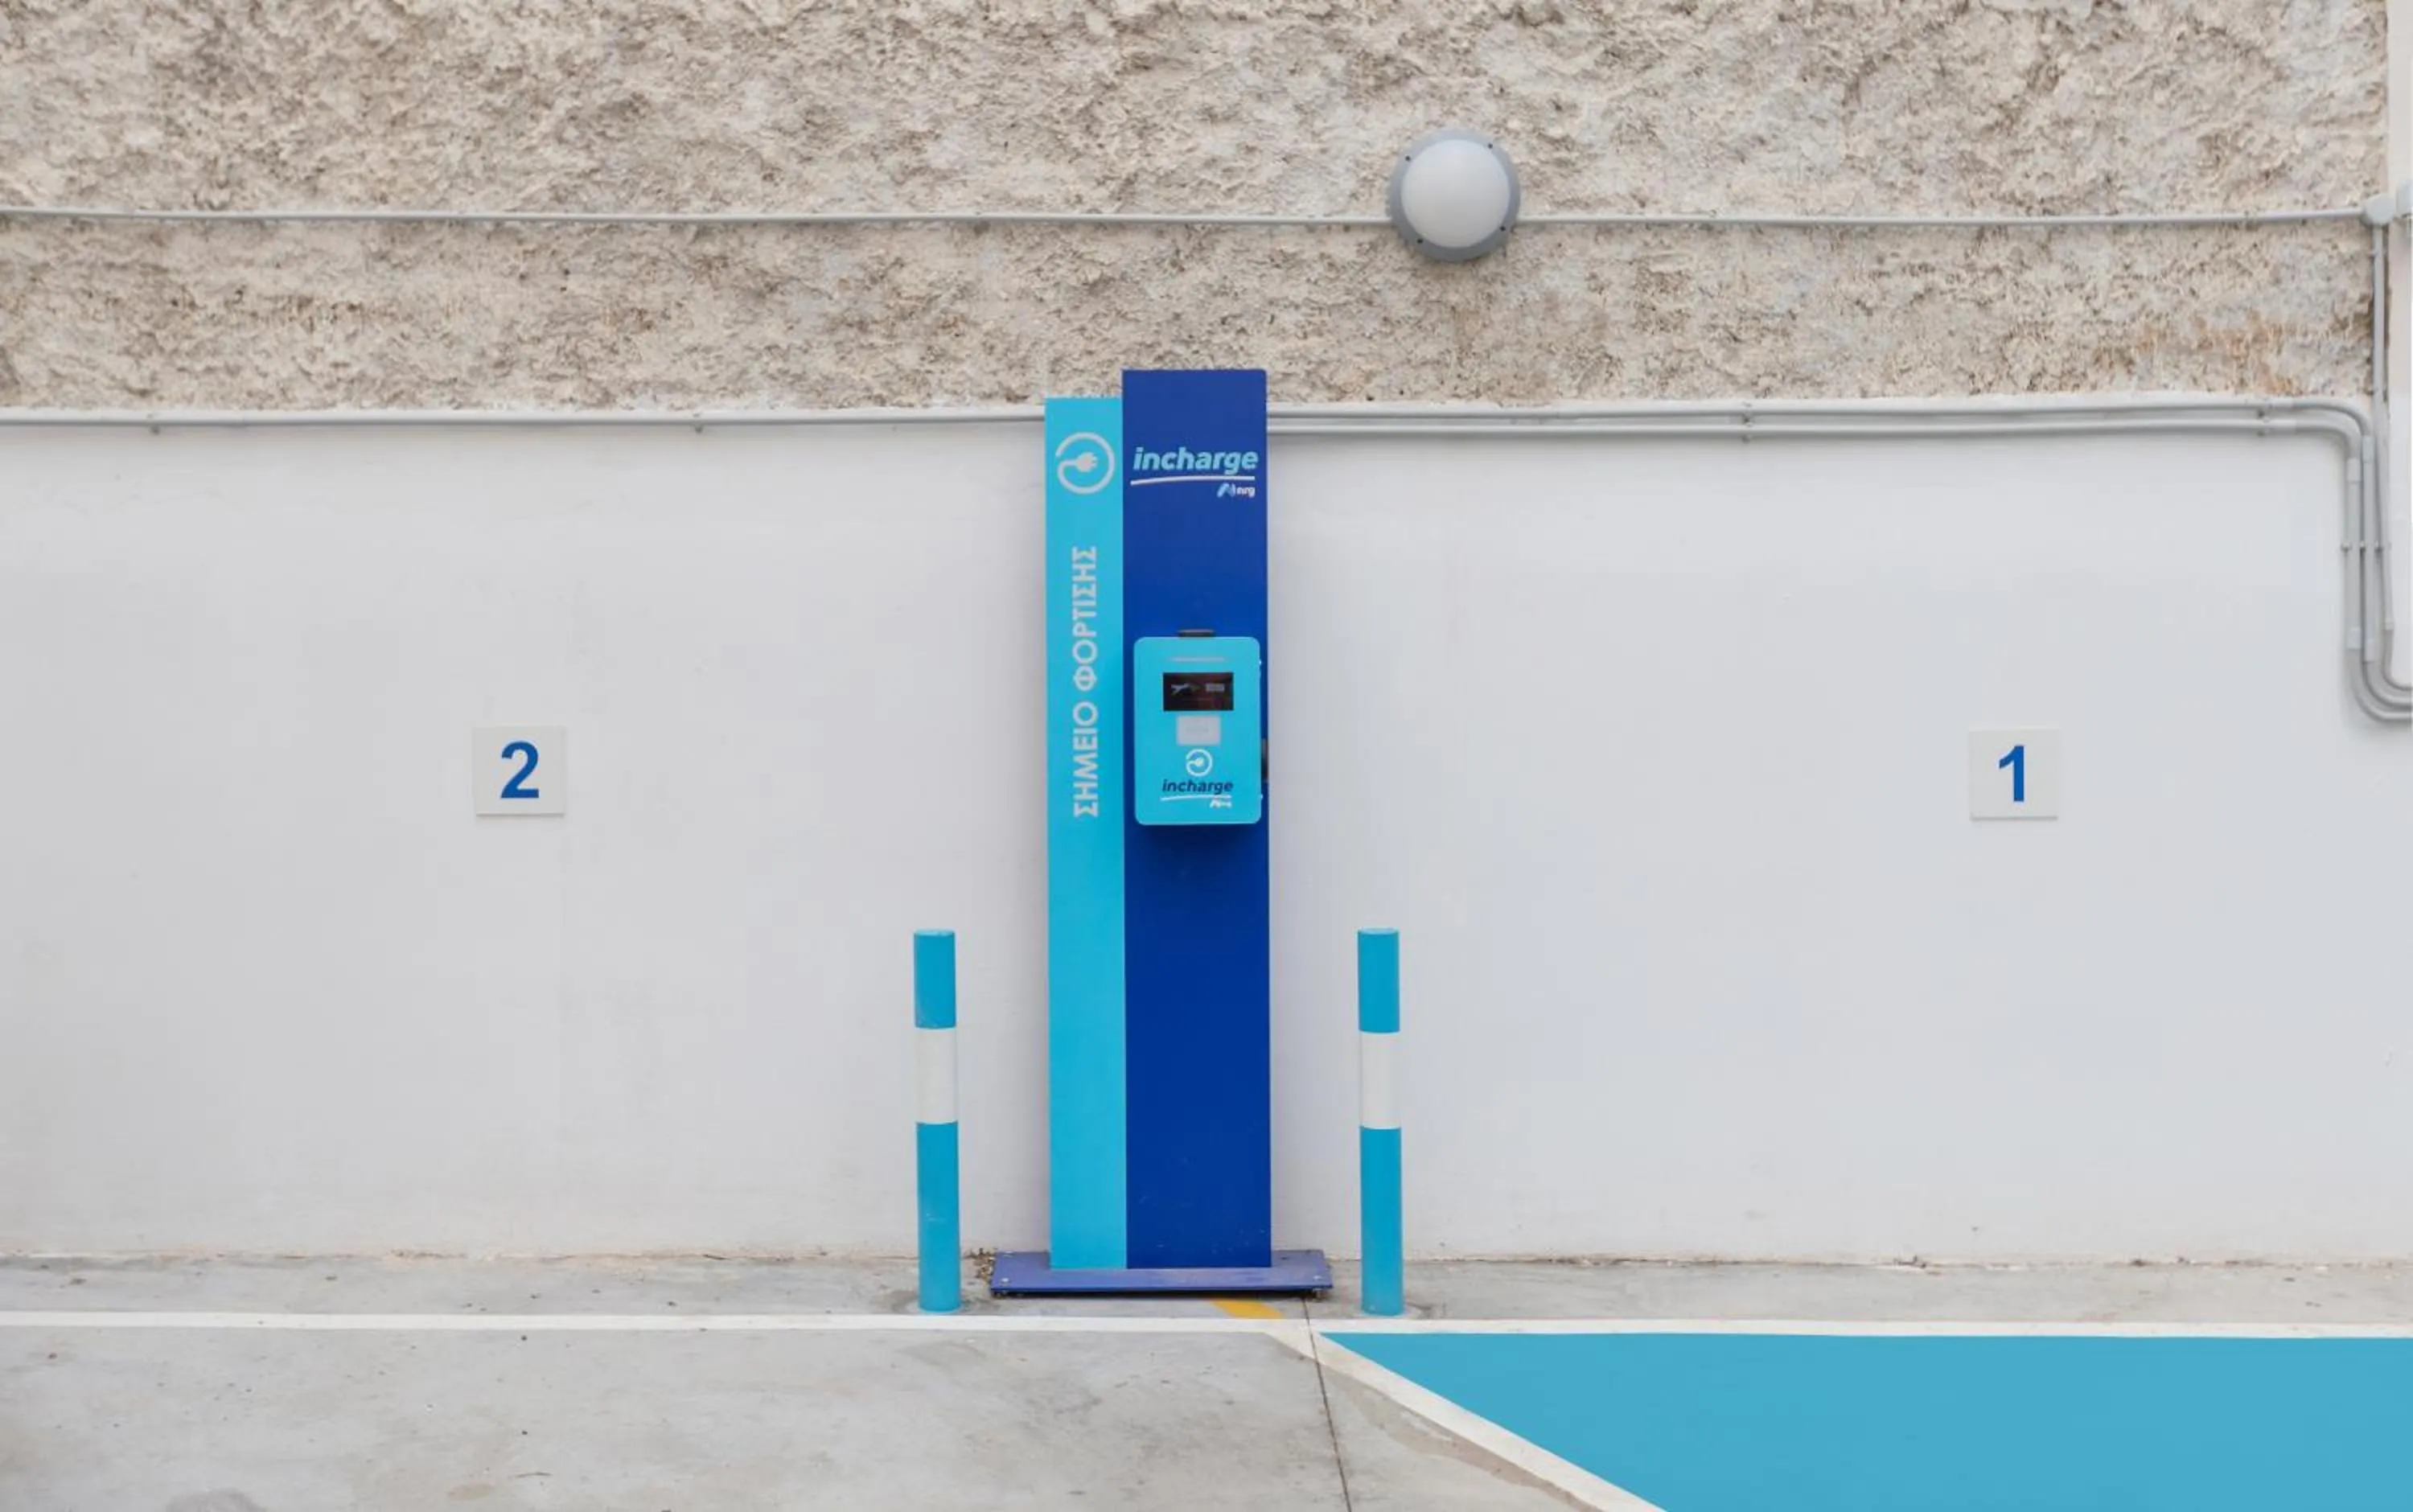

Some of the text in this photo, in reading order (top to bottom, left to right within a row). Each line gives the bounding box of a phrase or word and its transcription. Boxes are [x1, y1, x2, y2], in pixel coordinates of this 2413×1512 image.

[1133, 446, 1259, 476] incharge
[1071, 546, 1099, 818] ΣΗΜΕΙΟ ΦΟΡΤΙΣΗΣ
[500, 741, 540, 799] 2
[1162, 779, 1234, 795] incharge
[1999, 745, 2025, 802] 1
